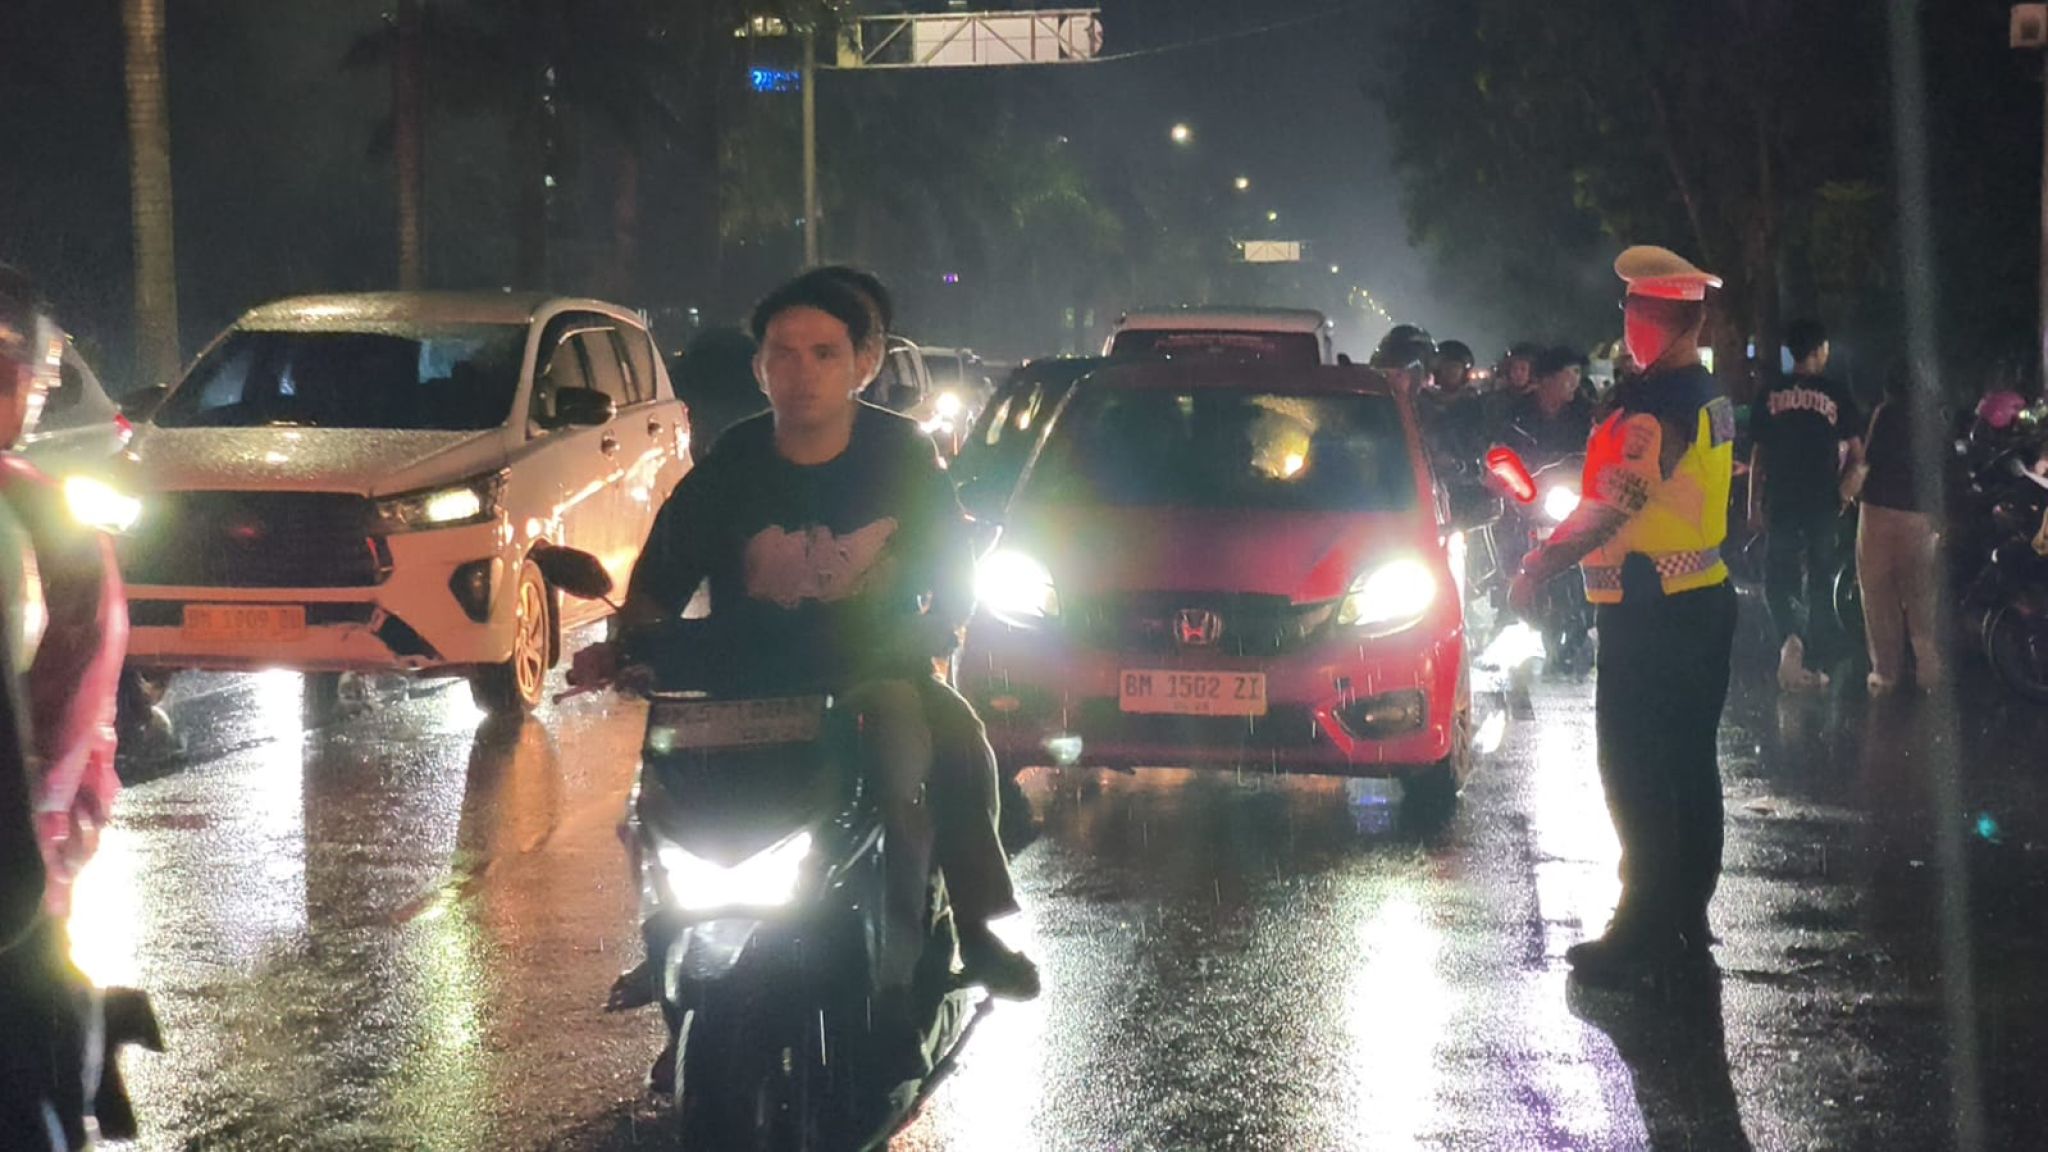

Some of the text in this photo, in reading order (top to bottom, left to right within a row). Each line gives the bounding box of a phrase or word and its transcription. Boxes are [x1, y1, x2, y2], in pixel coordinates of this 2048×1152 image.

[1125, 674, 1260, 700] BM 1502 ZI
